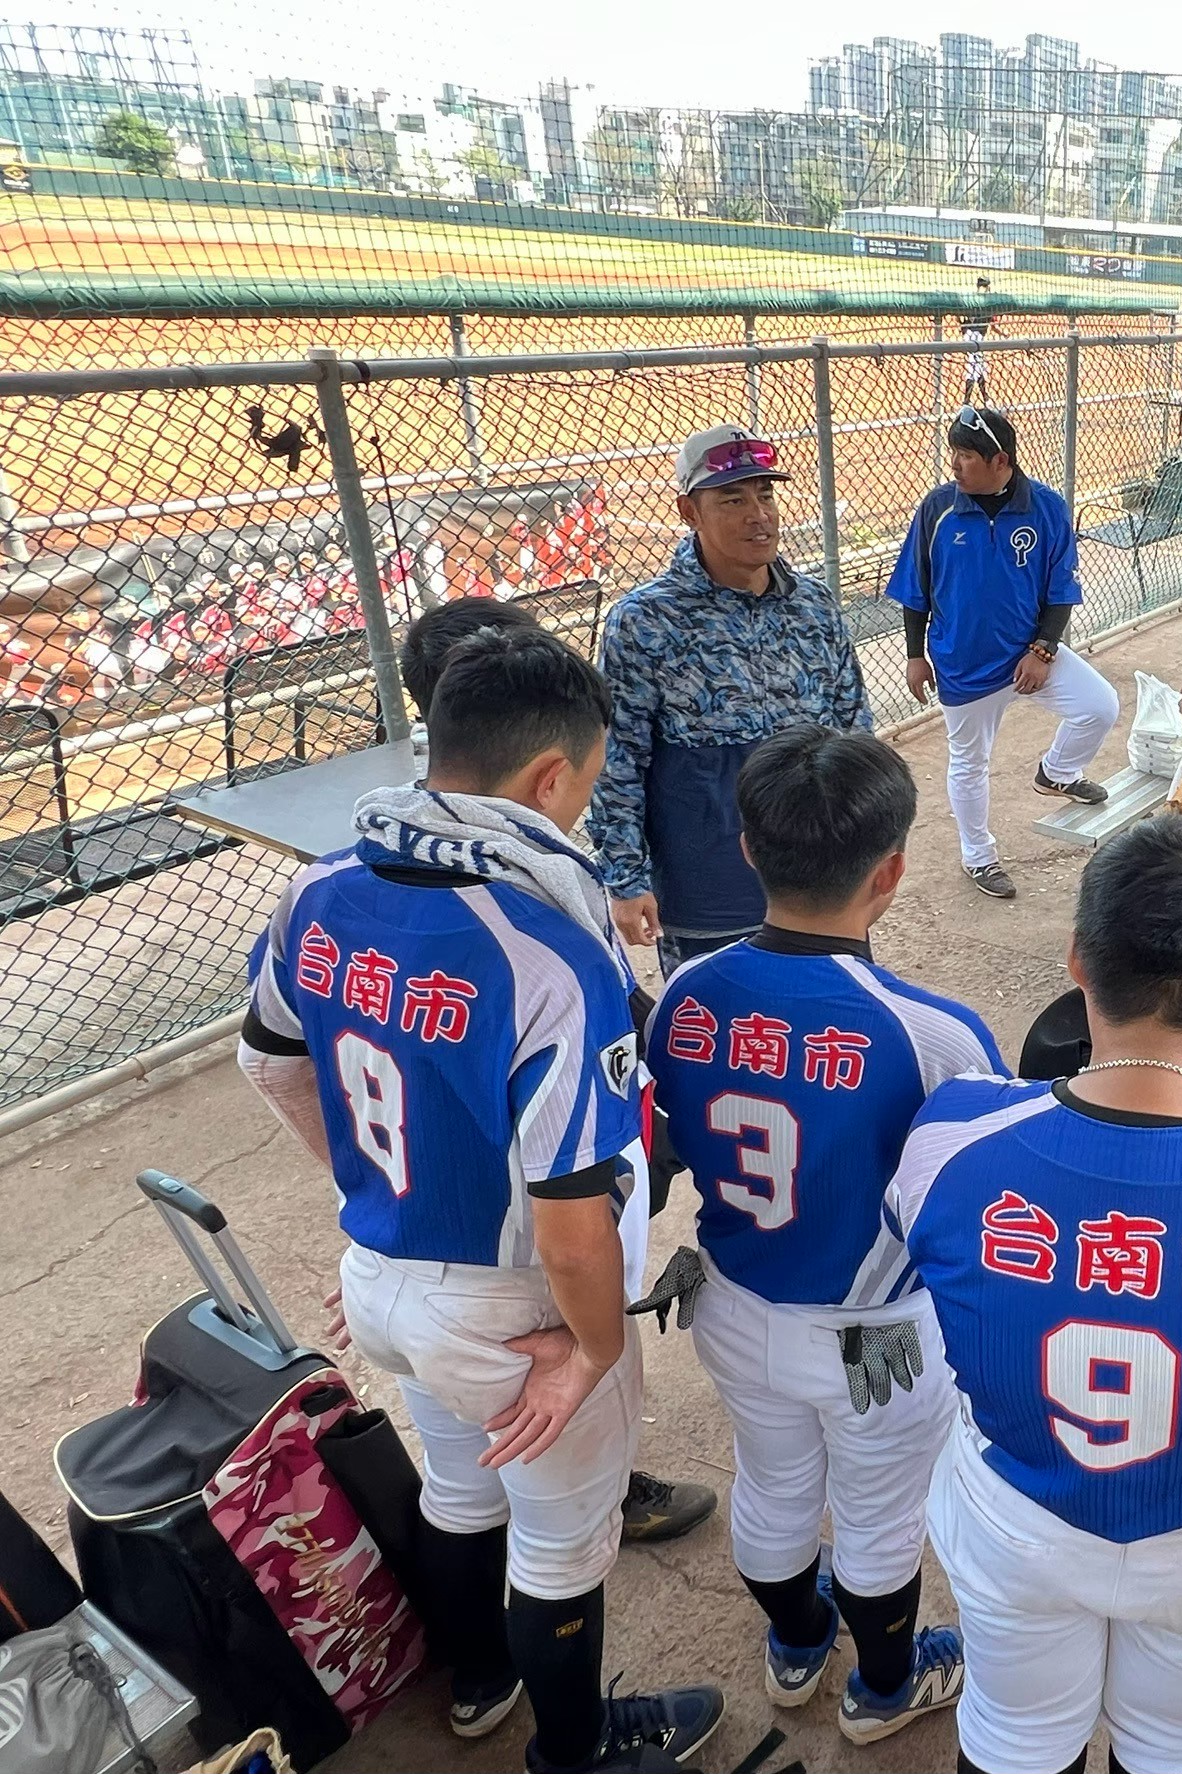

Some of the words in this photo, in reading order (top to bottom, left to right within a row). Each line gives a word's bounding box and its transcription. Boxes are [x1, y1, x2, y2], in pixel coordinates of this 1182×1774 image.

[296, 920, 478, 1043] 台南市
[667, 995, 872, 1090] 台南市
[333, 1029, 411, 1200] 8
[705, 1090, 802, 1231] 3
[1041, 1318, 1182, 1472] 9
